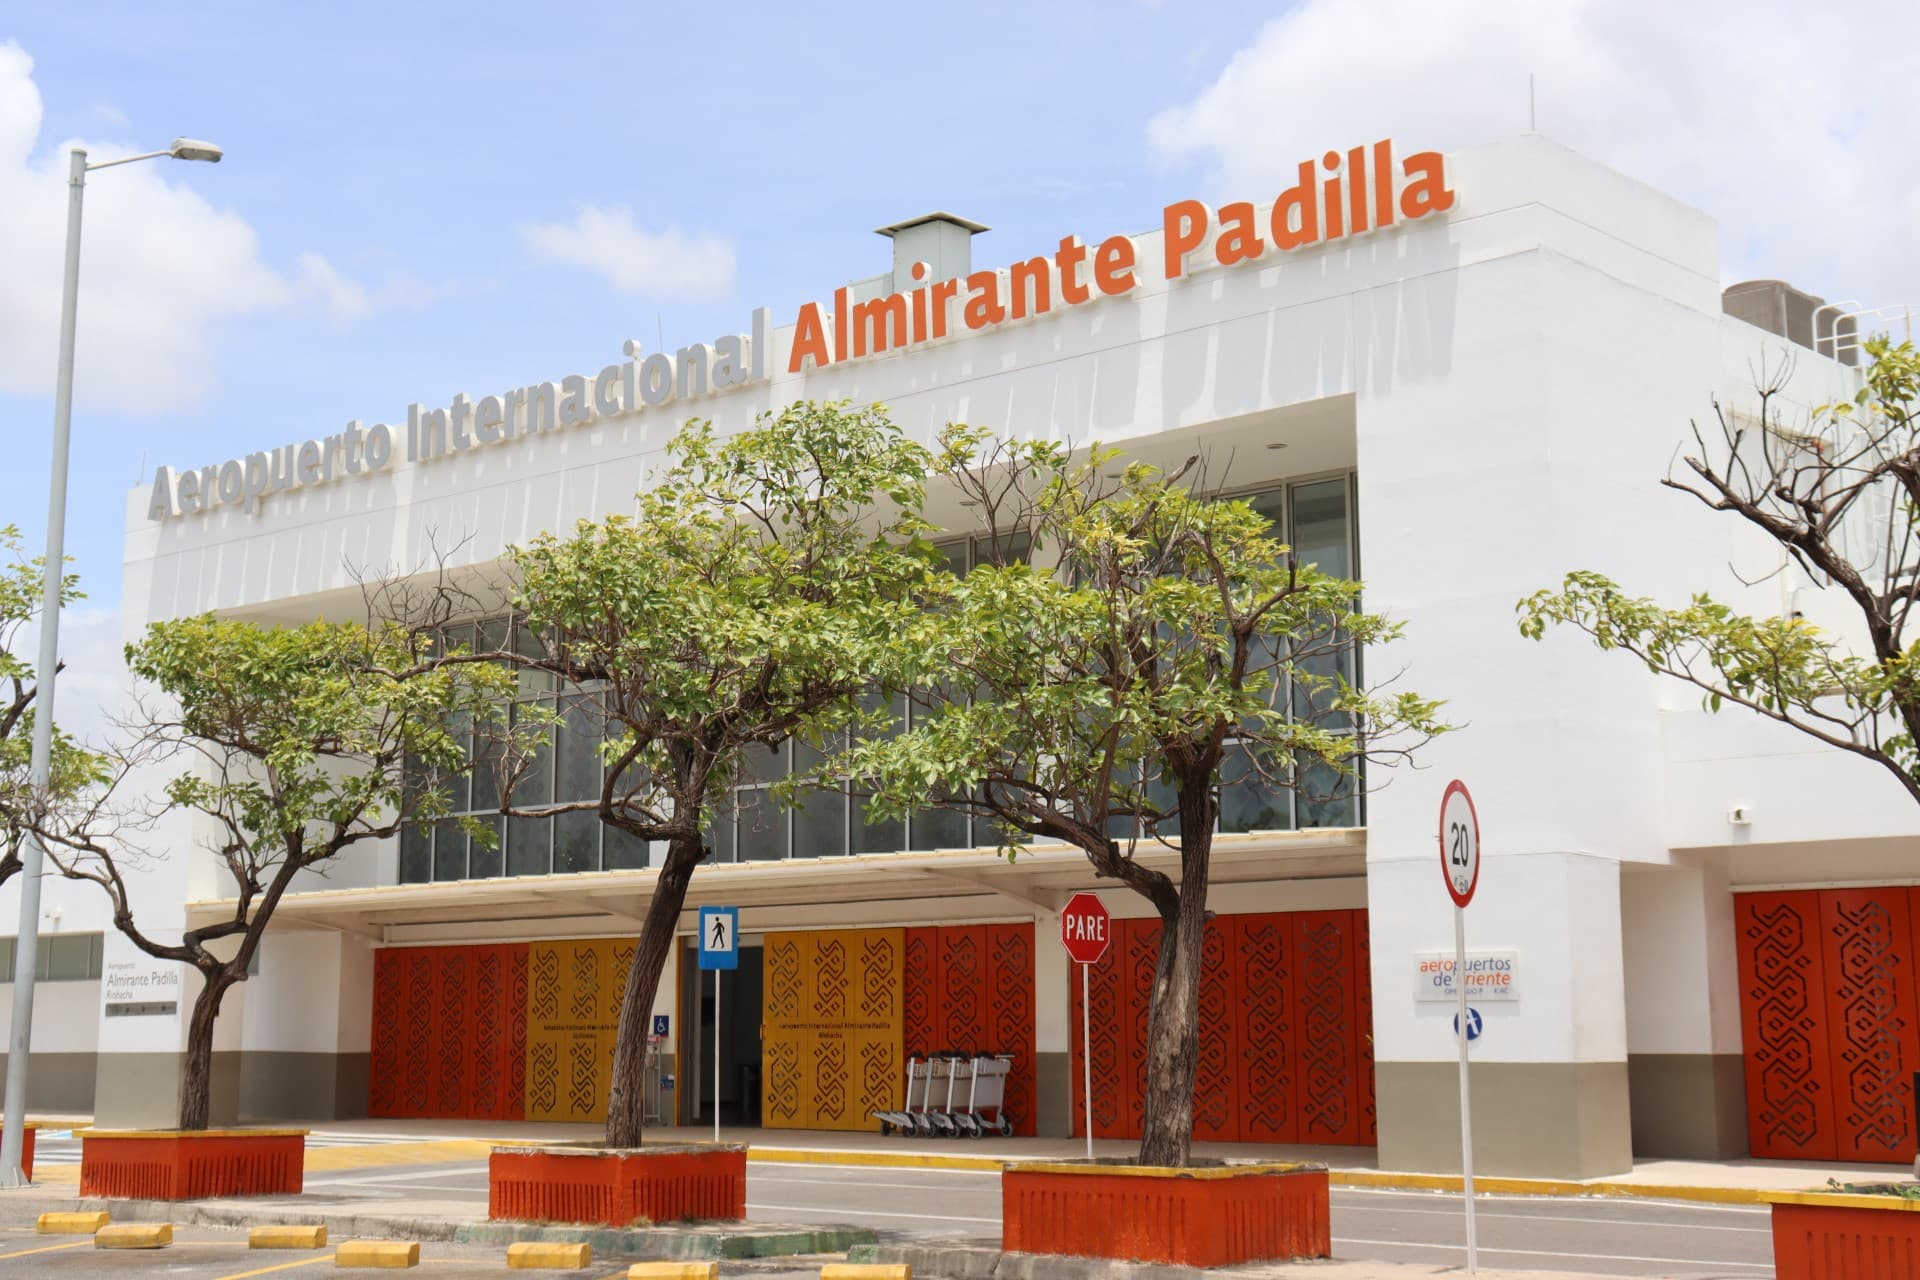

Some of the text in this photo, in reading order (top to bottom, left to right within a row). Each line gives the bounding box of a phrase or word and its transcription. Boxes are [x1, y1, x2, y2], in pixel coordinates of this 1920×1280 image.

[148, 138, 1456, 520] Aeropuerto Internacional Almirante Padilla
[1451, 822, 1469, 867] 20
[1066, 914, 1105, 941] PARE
[107, 971, 178, 987] Almirante Padilla
[1433, 971, 1512, 987] de riente
